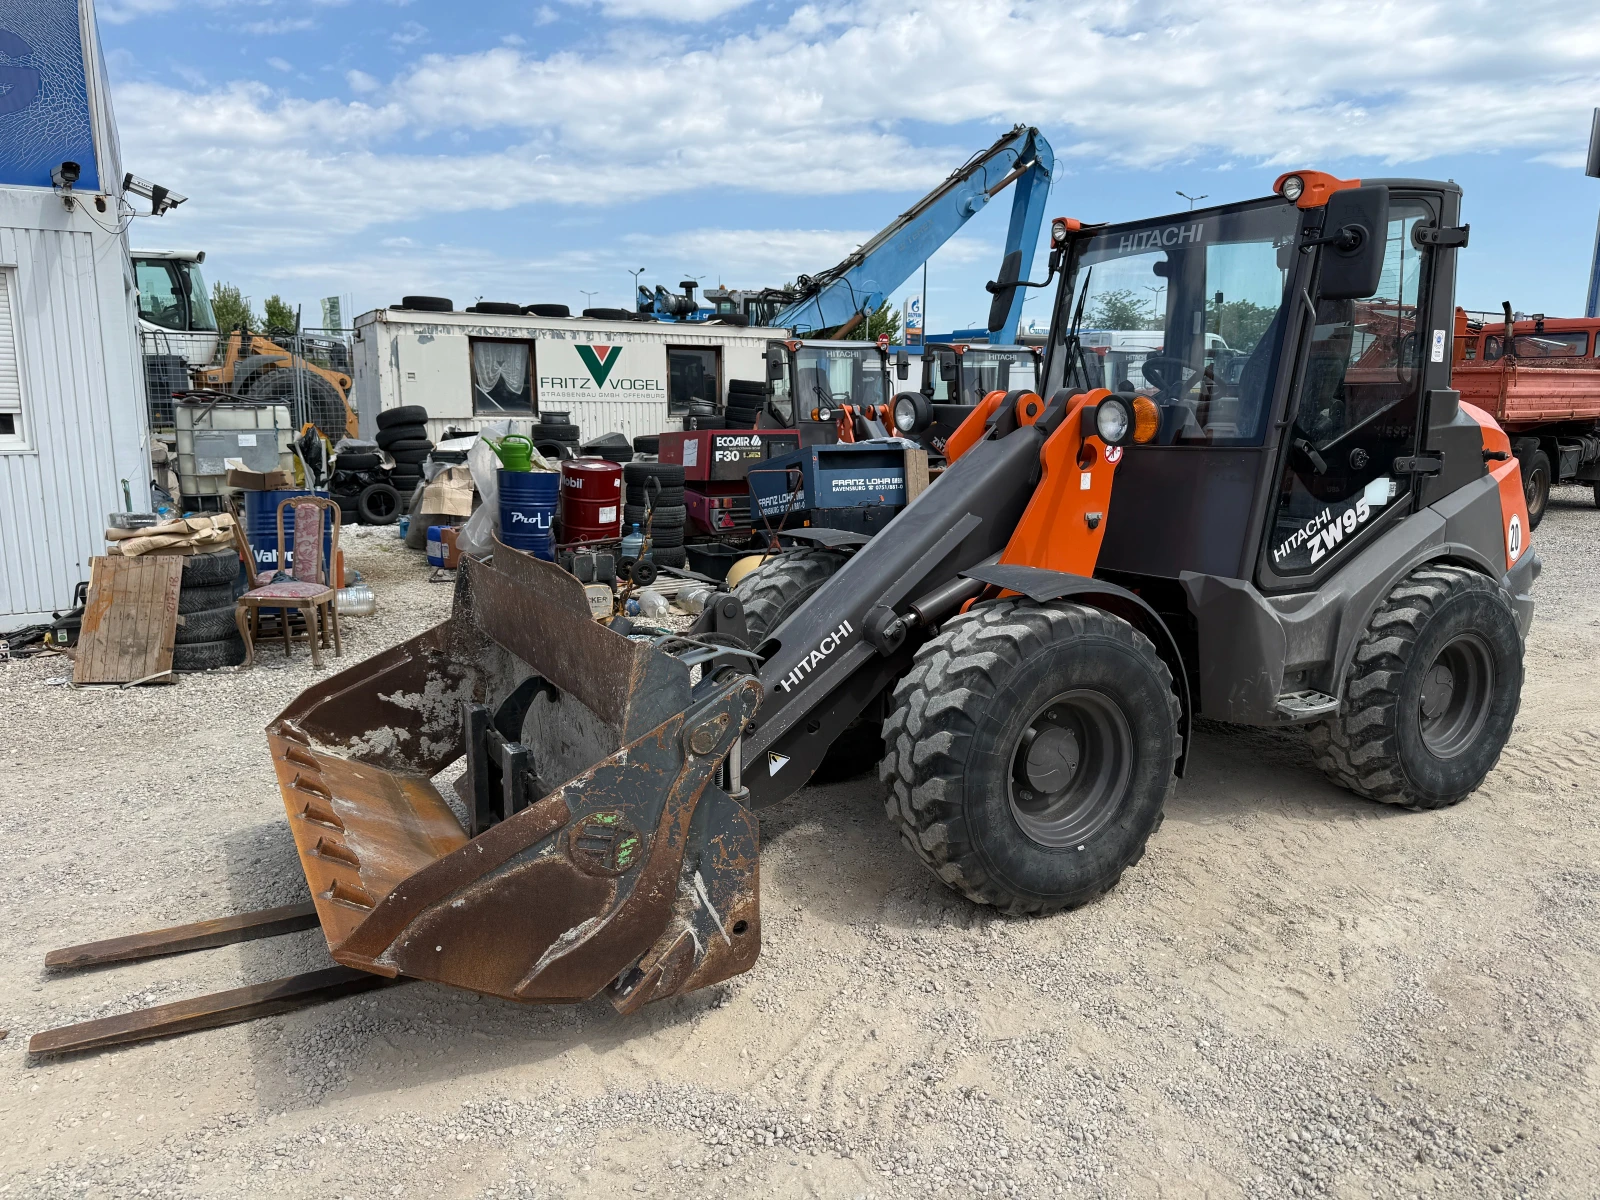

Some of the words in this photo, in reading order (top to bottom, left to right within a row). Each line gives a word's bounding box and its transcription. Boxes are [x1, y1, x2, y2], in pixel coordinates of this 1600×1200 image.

[1118, 223, 1204, 254] HITACHI
[826, 350, 859, 358] HITACHI
[988, 353, 1018, 361] HITACHI
[540, 377, 591, 389] FRITZ
[609, 378, 665, 391] VOGEL
[716, 436, 750, 447] ECOAIR
[932, 436, 945, 452] ZW
[715, 450, 740, 462] F30
[832, 478, 865, 486] FRANZ
[866, 477, 891, 485] LOHR
[758, 495, 778, 507] FRANZ
[1273, 507, 1331, 563] HITACHI
[1306, 496, 1370, 565] ZW95
[1510, 523, 1520, 552] 20
[780, 619, 854, 693] HITACHI
